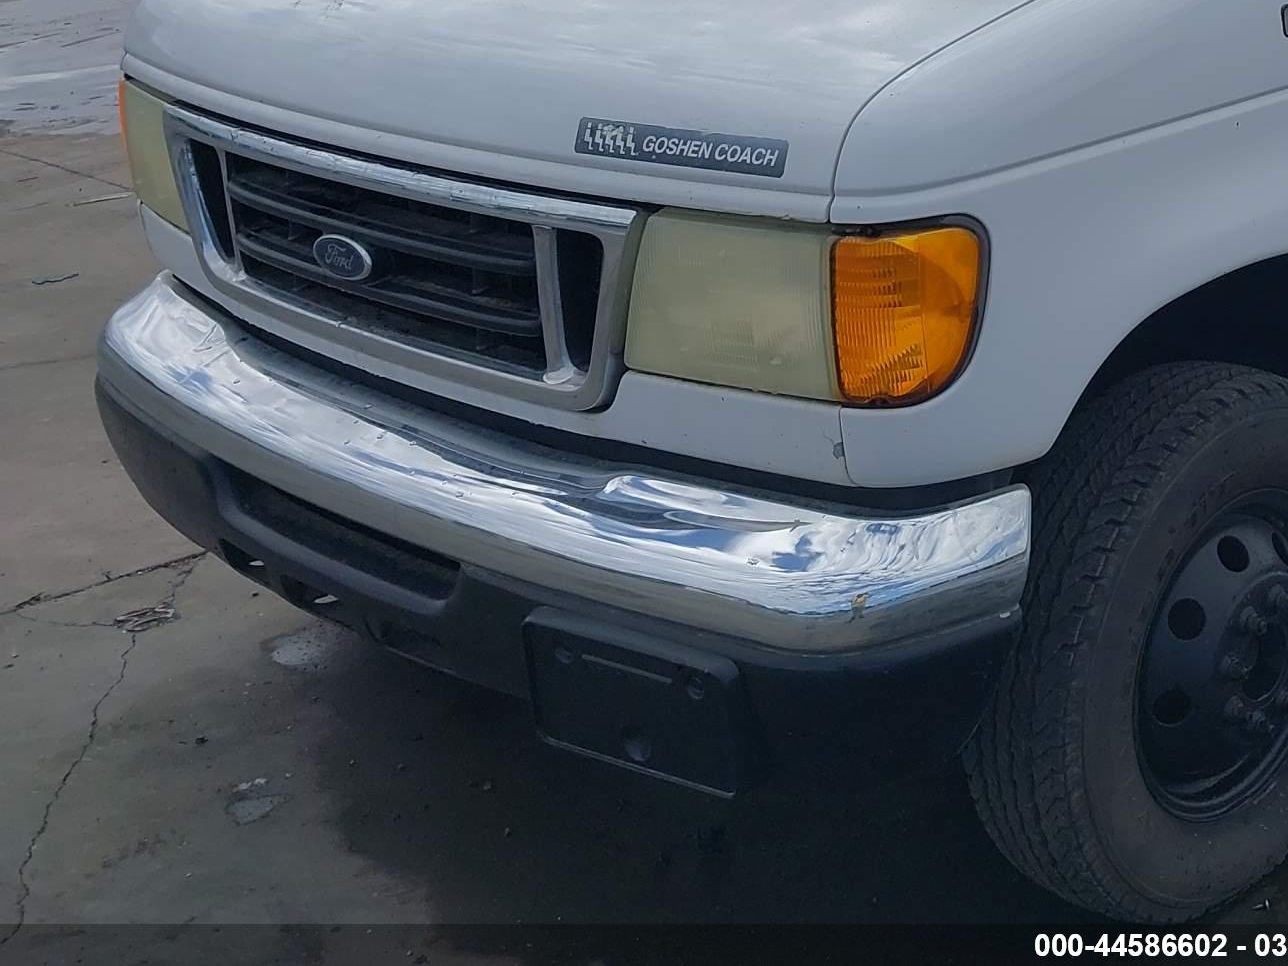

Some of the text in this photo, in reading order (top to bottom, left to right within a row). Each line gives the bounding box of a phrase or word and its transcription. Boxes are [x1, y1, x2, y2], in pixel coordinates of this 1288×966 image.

[643, 136, 779, 167] GOSHEN COACH
[325, 243, 354, 271] Ford
